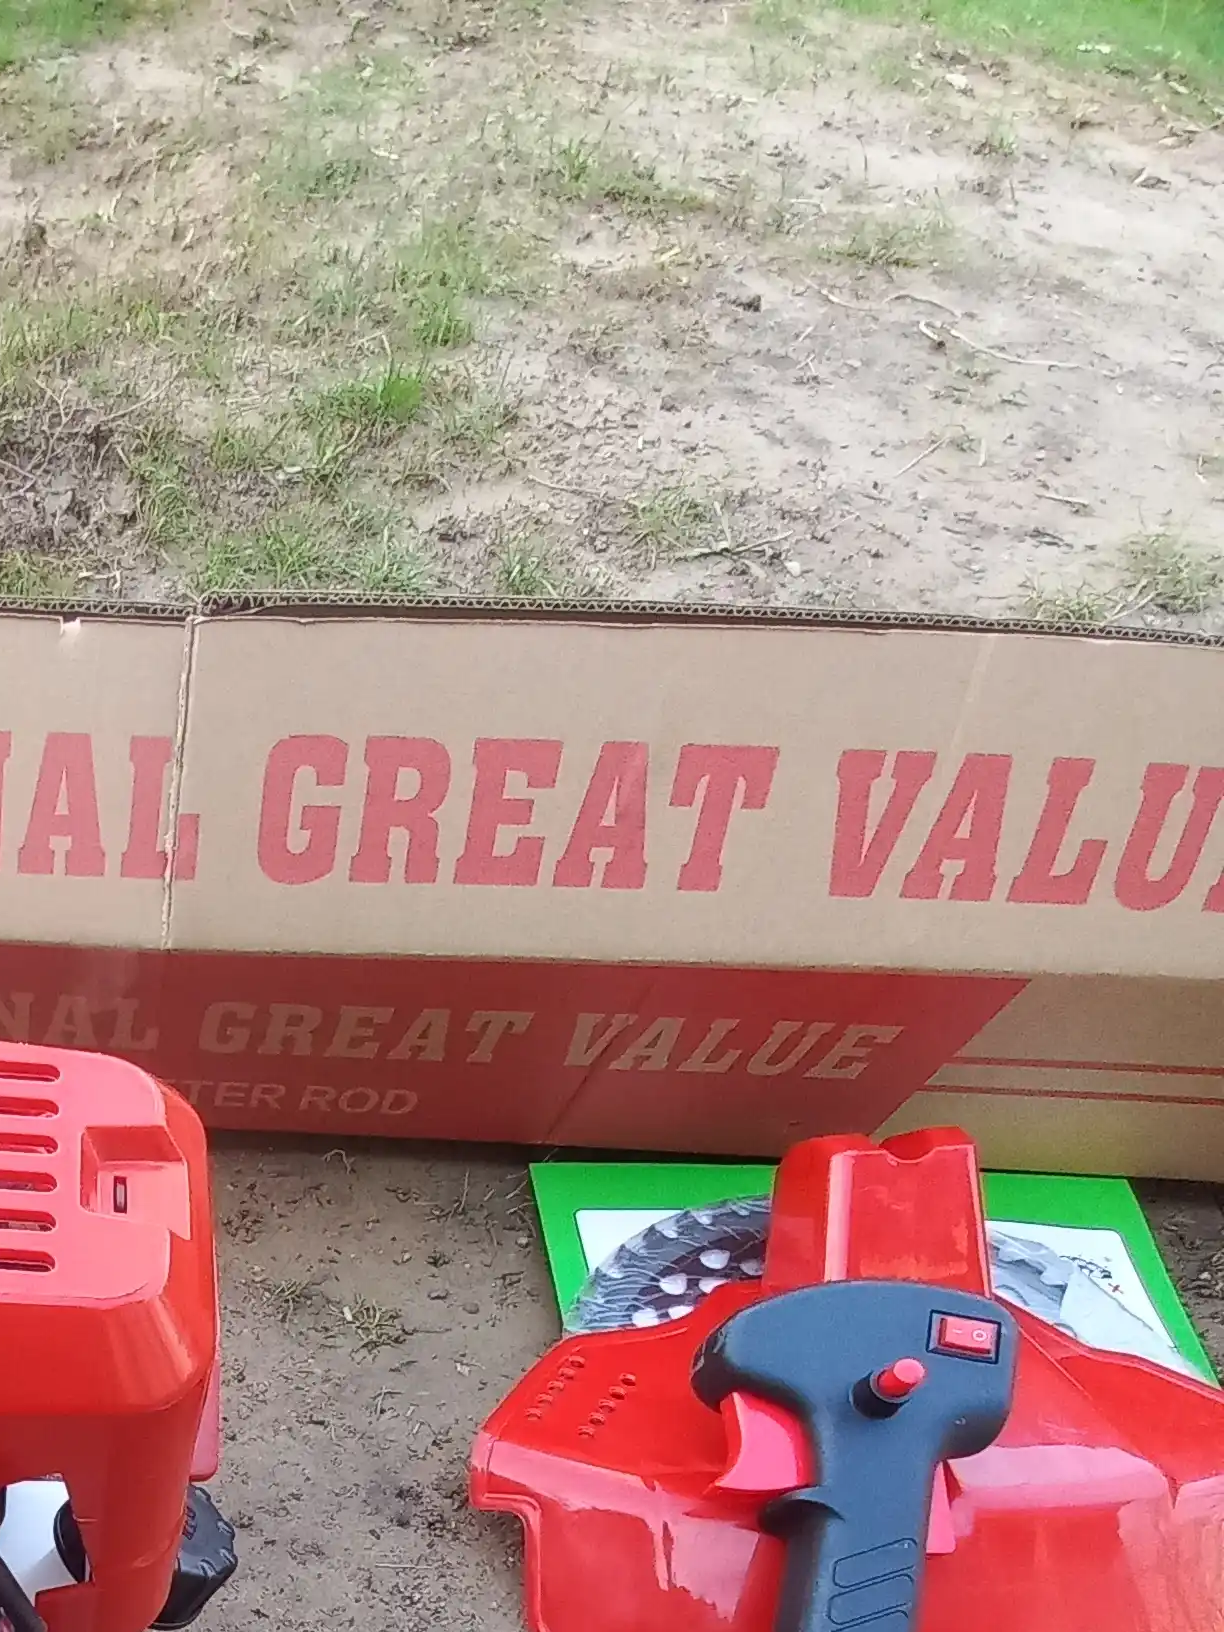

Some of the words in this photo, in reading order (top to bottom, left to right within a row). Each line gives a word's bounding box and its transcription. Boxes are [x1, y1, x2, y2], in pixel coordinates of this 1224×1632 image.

[257, 733, 780, 892] GREAT
[828, 748, 1224, 912] VALU
[198, 1001, 536, 1063] GREAT
[563, 1012, 908, 1080] VALUE
[298, 1085, 418, 1115] ROD
